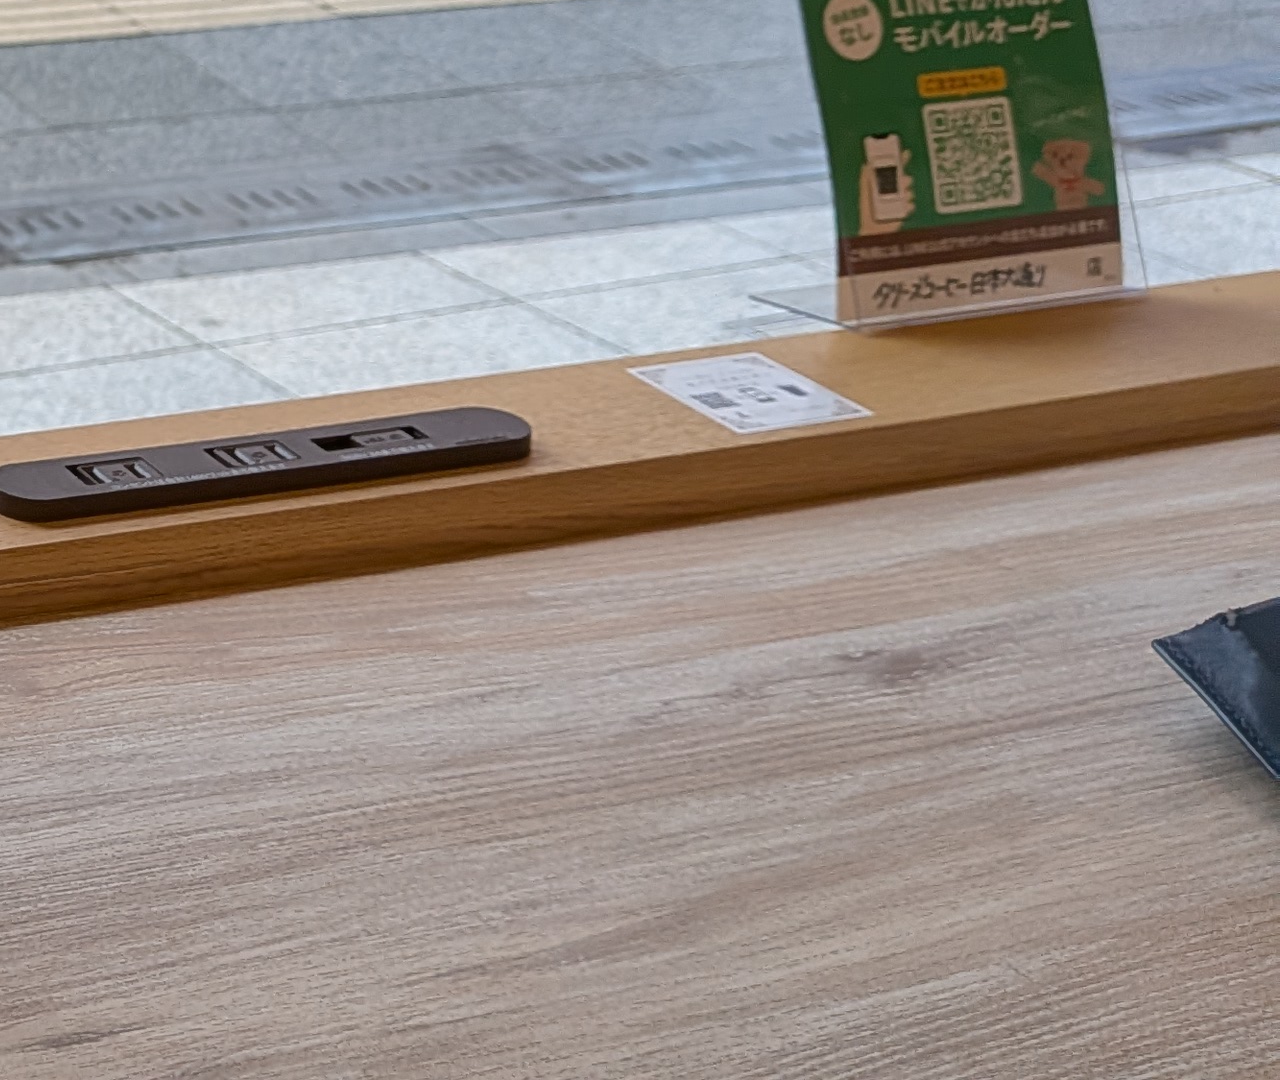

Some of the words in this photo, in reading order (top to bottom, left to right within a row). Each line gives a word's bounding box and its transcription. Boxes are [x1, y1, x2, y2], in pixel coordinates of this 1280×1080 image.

[893, 10, 1072, 52] モバイルオーダー
